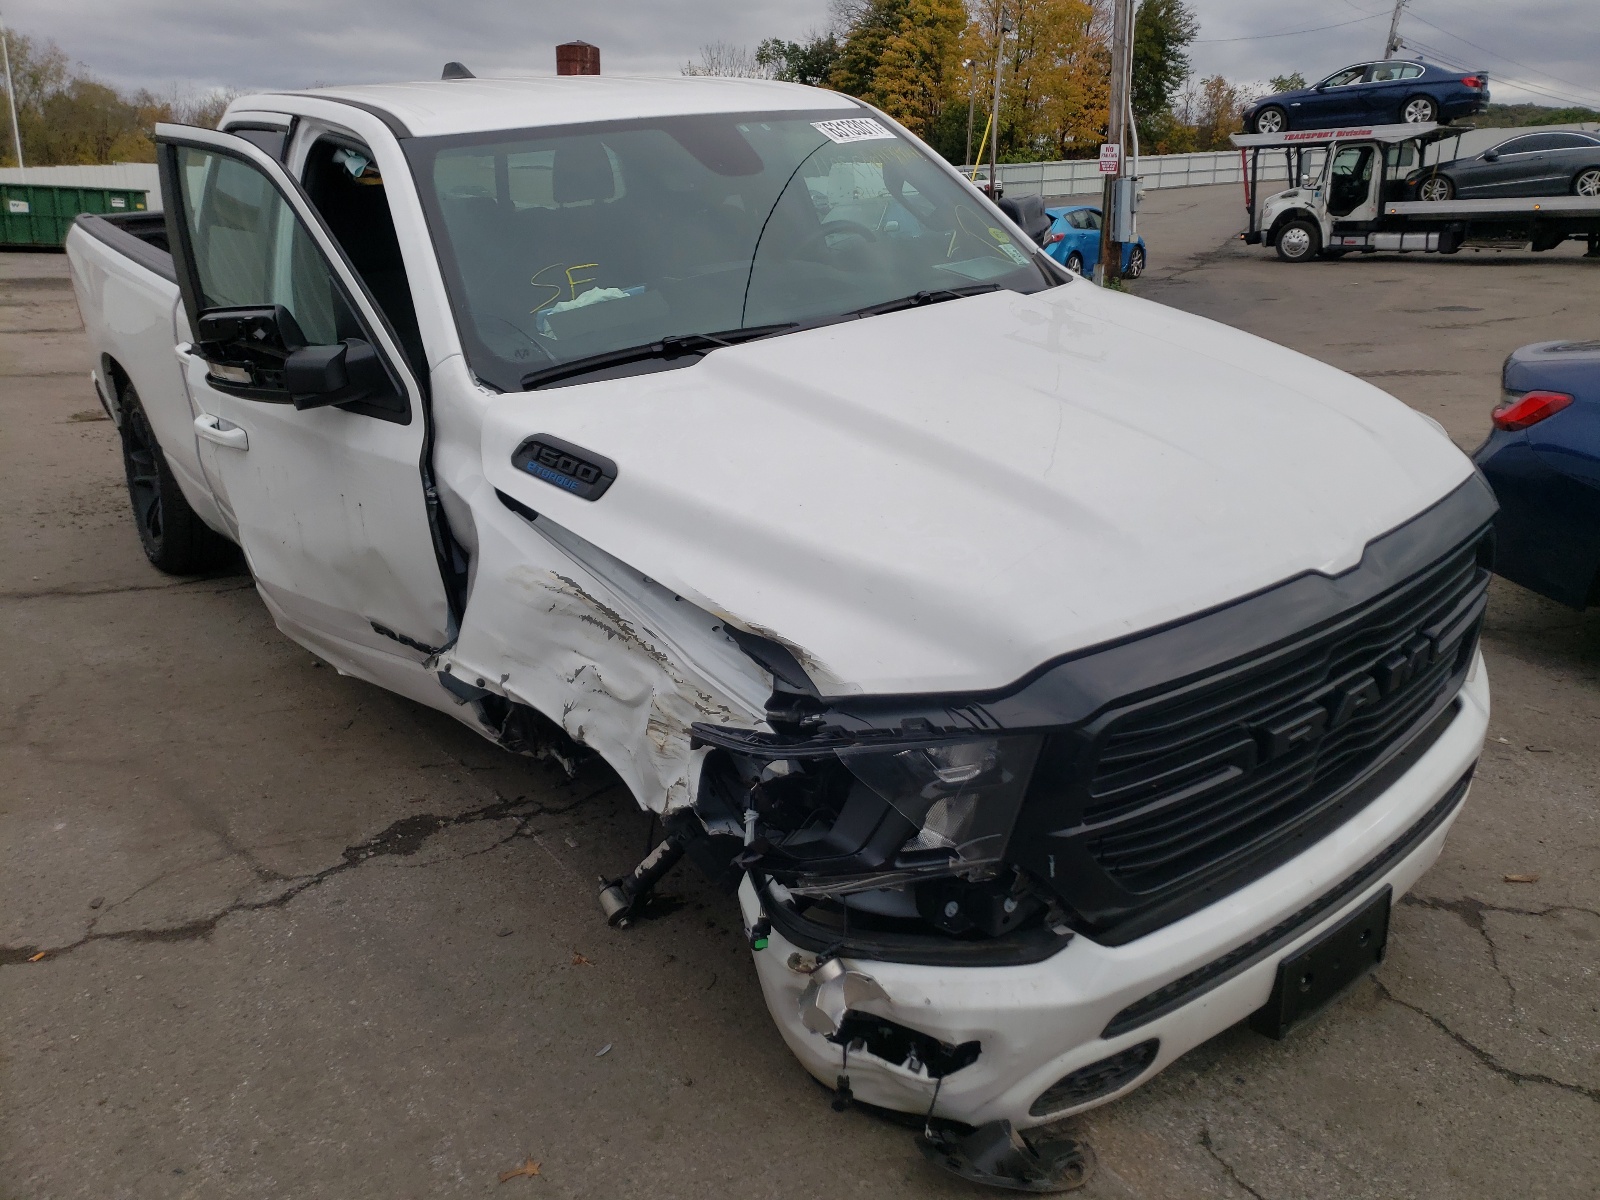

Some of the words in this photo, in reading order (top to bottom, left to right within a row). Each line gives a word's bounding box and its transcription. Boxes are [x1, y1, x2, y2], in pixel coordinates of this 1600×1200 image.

[1284, 131, 1335, 140] TRANSPORT
[1336, 129, 1373, 137] Division
[518, 443, 601, 484] 1500
[1266, 636, 1432, 763] RAM
